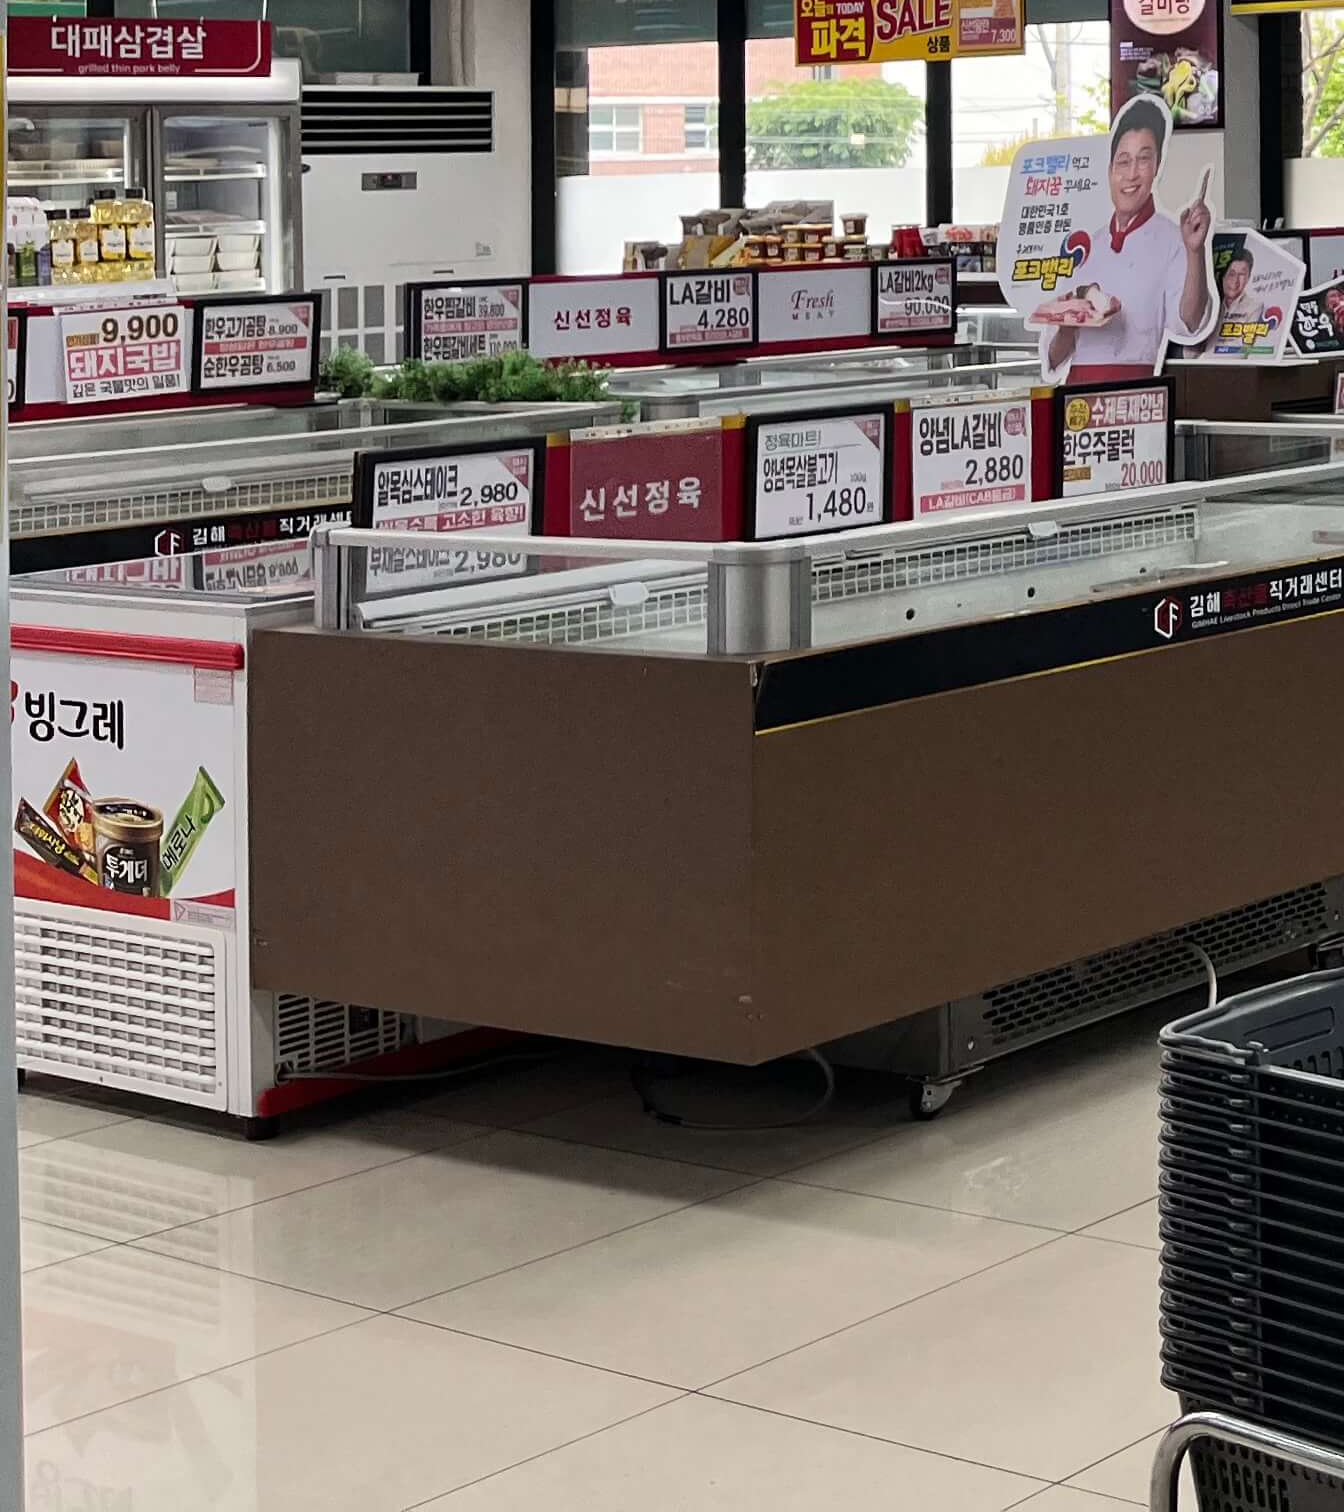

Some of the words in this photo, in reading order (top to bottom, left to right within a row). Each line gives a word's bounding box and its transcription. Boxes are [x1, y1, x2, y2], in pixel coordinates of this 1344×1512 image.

[835, 1, 865, 15] TODAY
[51, 24, 207, 59] 대패삼겹살
[811, 17, 866, 58] 파격
[926, 35, 950, 54] 상품
[78, 64, 109, 74] grilled
[111, 63, 131, 74] thin
[133, 64, 154, 75] pork
[157, 64, 180, 75] belly
[1021, 202, 1070, 219] 대한민국1호
[880, 268, 934, 295] LA갈비2kg
[1012, 256, 1074, 291] 포크밸리
[669, 279, 731, 305] LA갈비
[791, 289, 834, 311] Fresh
[424, 296, 476, 320] 한우찜갈비
[554, 306, 632, 331] 신선정육
[792, 310, 836, 321] MEAT
[102, 313, 178, 343] 9,900
[205, 315, 266, 340] 한우고기곰탕
[1220, 321, 1270, 345] 포크밸리
[69, 341, 179, 379] 돼지국밥
[204, 354, 264, 378] 순한우곰탕
[73, 382, 97, 398] 깊은
[100, 377, 149, 395] 국물맛의
[919, 411, 1001, 456] 양념LA갈비
[1063, 428, 1135, 465] 한우주물럭
[763, 450, 838, 493] 양념목살불고기
[964, 454, 1024, 486] 2,880
[460, 481, 518, 507] 2,980
[579, 476, 702, 522] 신선정육
[806, 486, 866, 523] 1,480
[443, 510, 486, 530] 고소한
[454, 550, 520, 574] 2,980
[1219, 611, 1251, 625] Livestock
[24, 690, 124, 751] 빙그레
[162, 814, 197, 871] 메로나
[106, 854, 148, 883] 투게더
